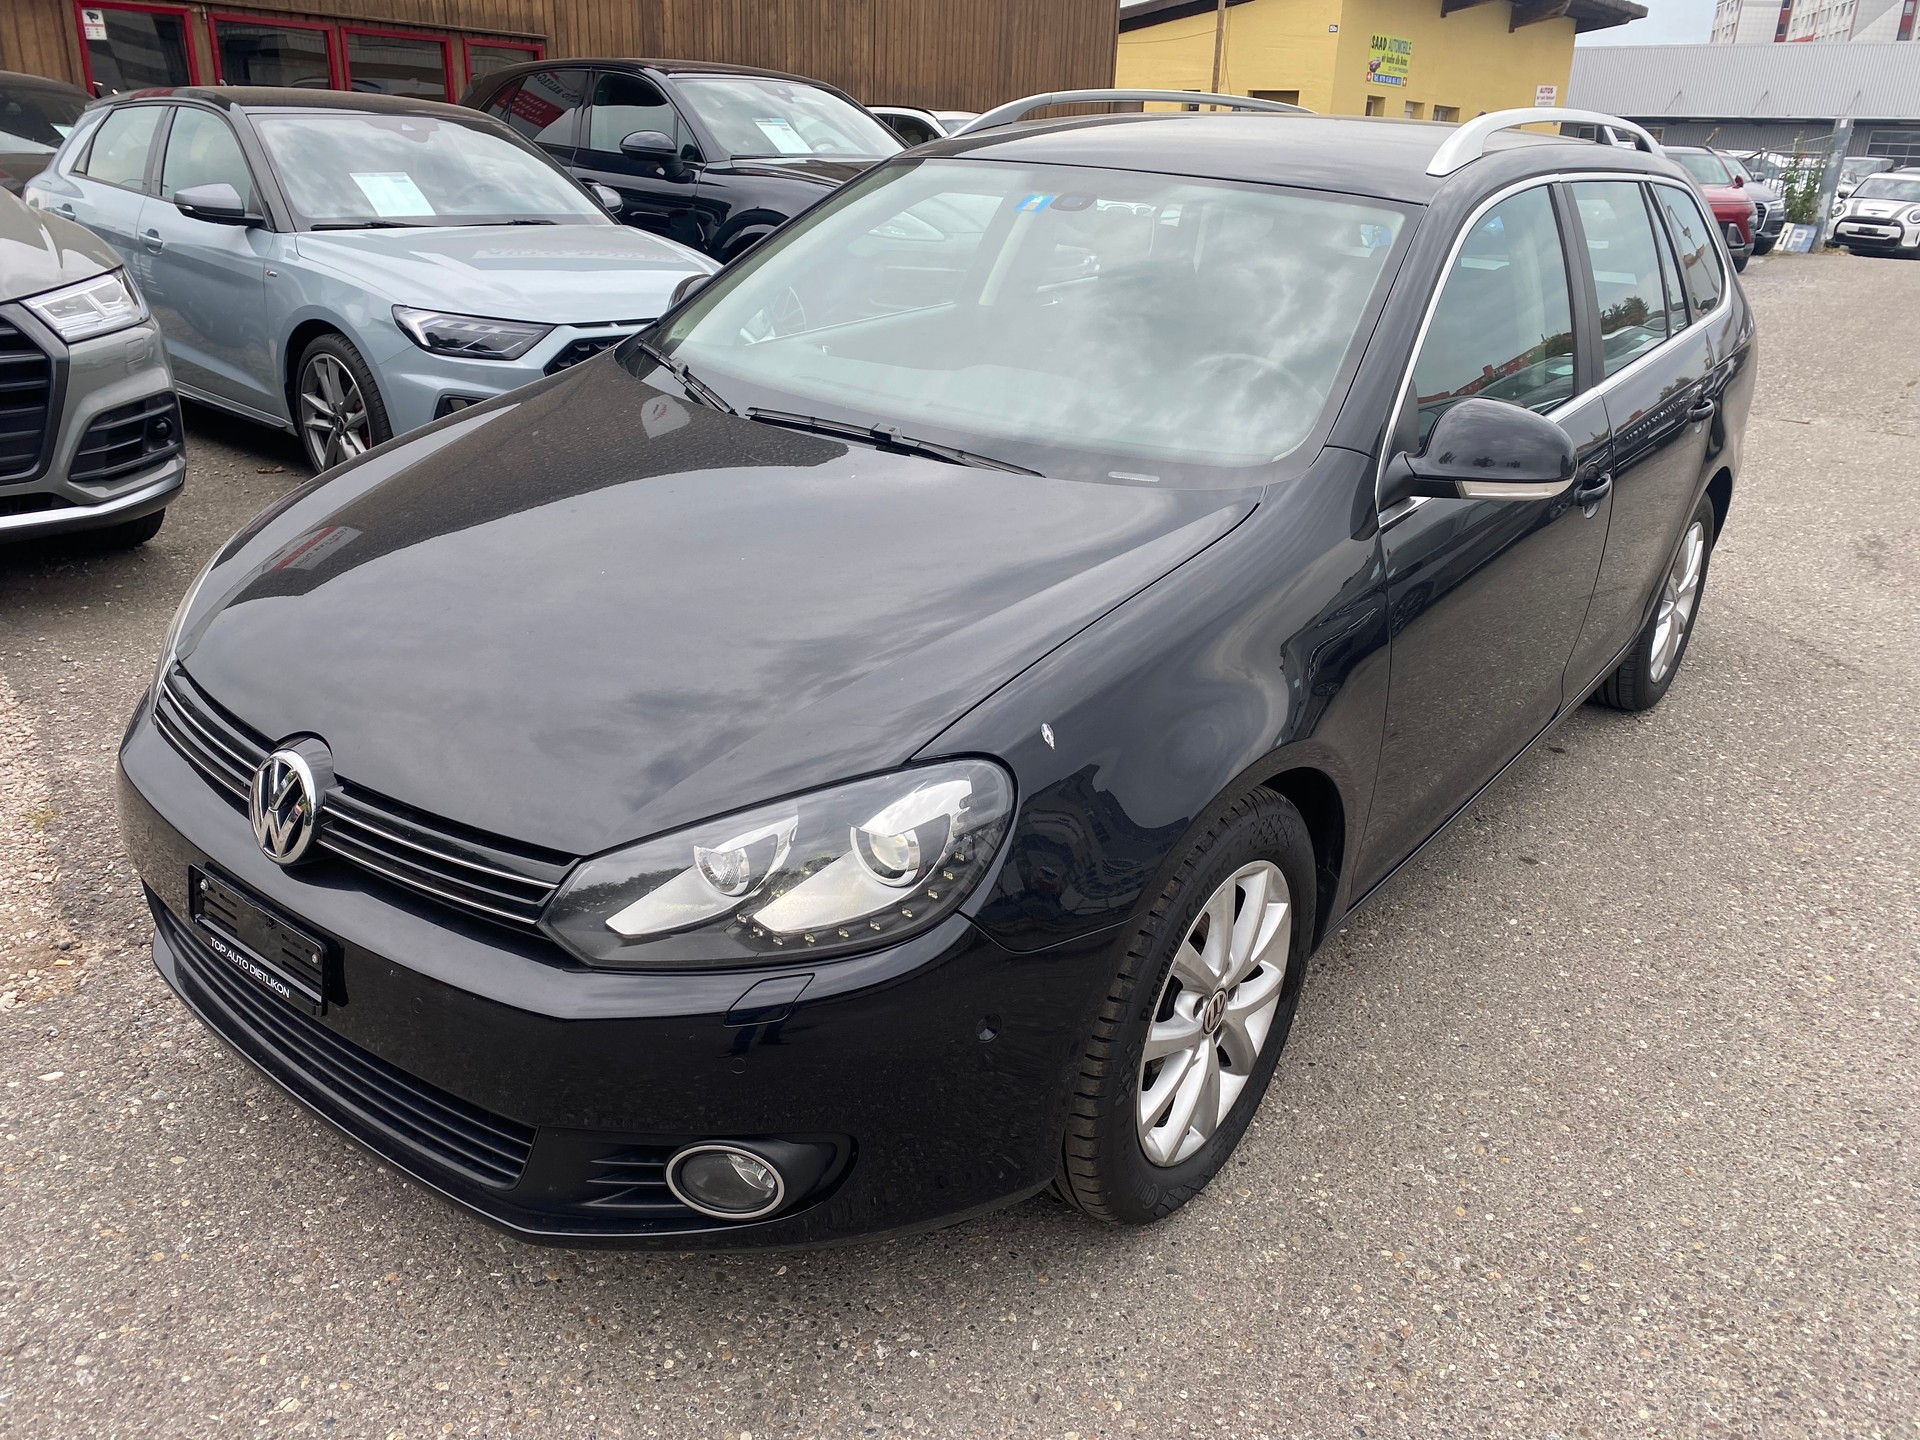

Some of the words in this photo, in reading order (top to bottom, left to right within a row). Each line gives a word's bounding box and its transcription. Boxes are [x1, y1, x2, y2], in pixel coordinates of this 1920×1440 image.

[1371, 35, 1387, 51] SAAD
[1788, 228, 1808, 248] P
[210, 937, 226, 953] TOP
[226, 949, 249, 970] AUTO
[249, 965, 290, 999] DIETLIKON
